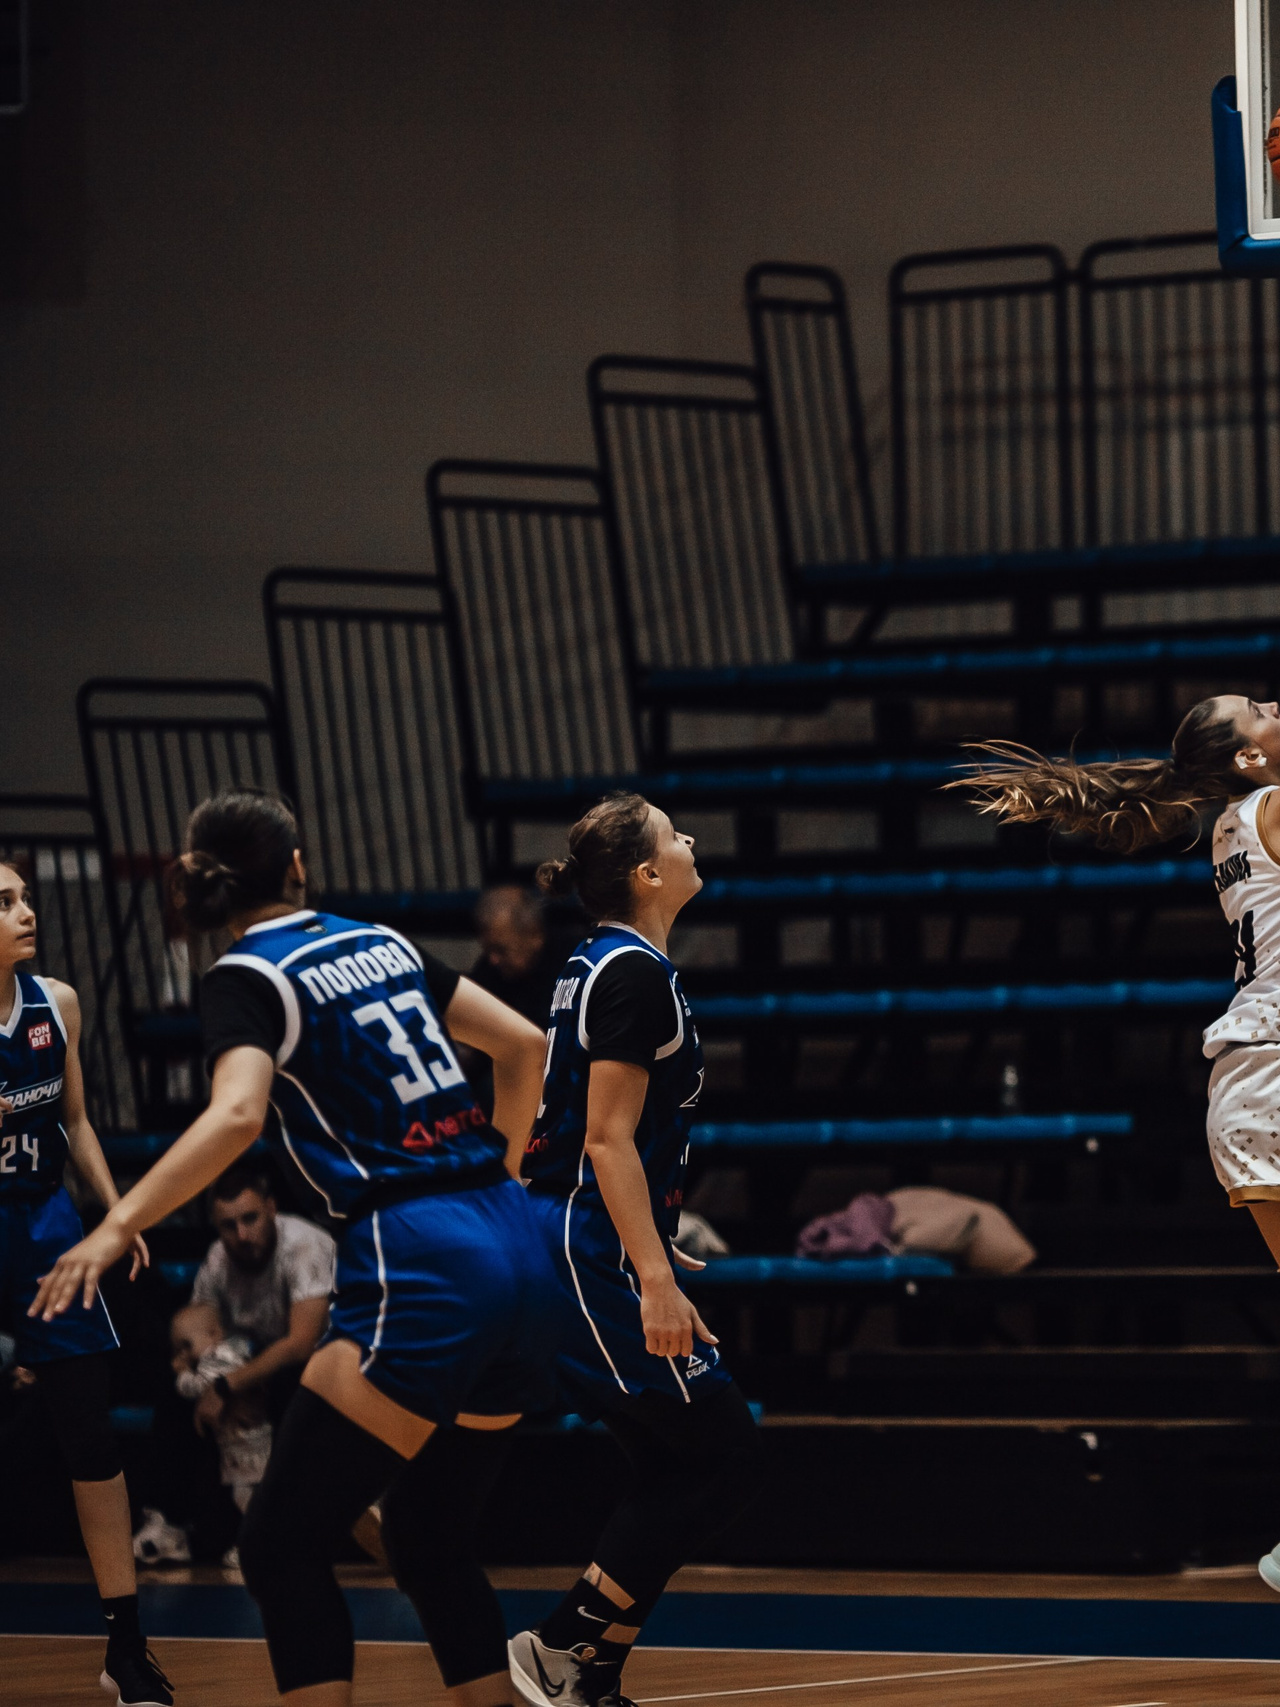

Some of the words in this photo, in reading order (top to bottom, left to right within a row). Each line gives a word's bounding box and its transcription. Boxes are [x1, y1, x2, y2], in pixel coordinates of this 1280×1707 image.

[297, 941, 419, 1006] ПОПОВА
[28, 1024, 50, 1039] FON
[31, 1034, 52, 1049] BET
[351, 988, 468, 1105] 33
[0, 1133, 39, 1174] 24
[685, 1361, 711, 1380] PEAK
